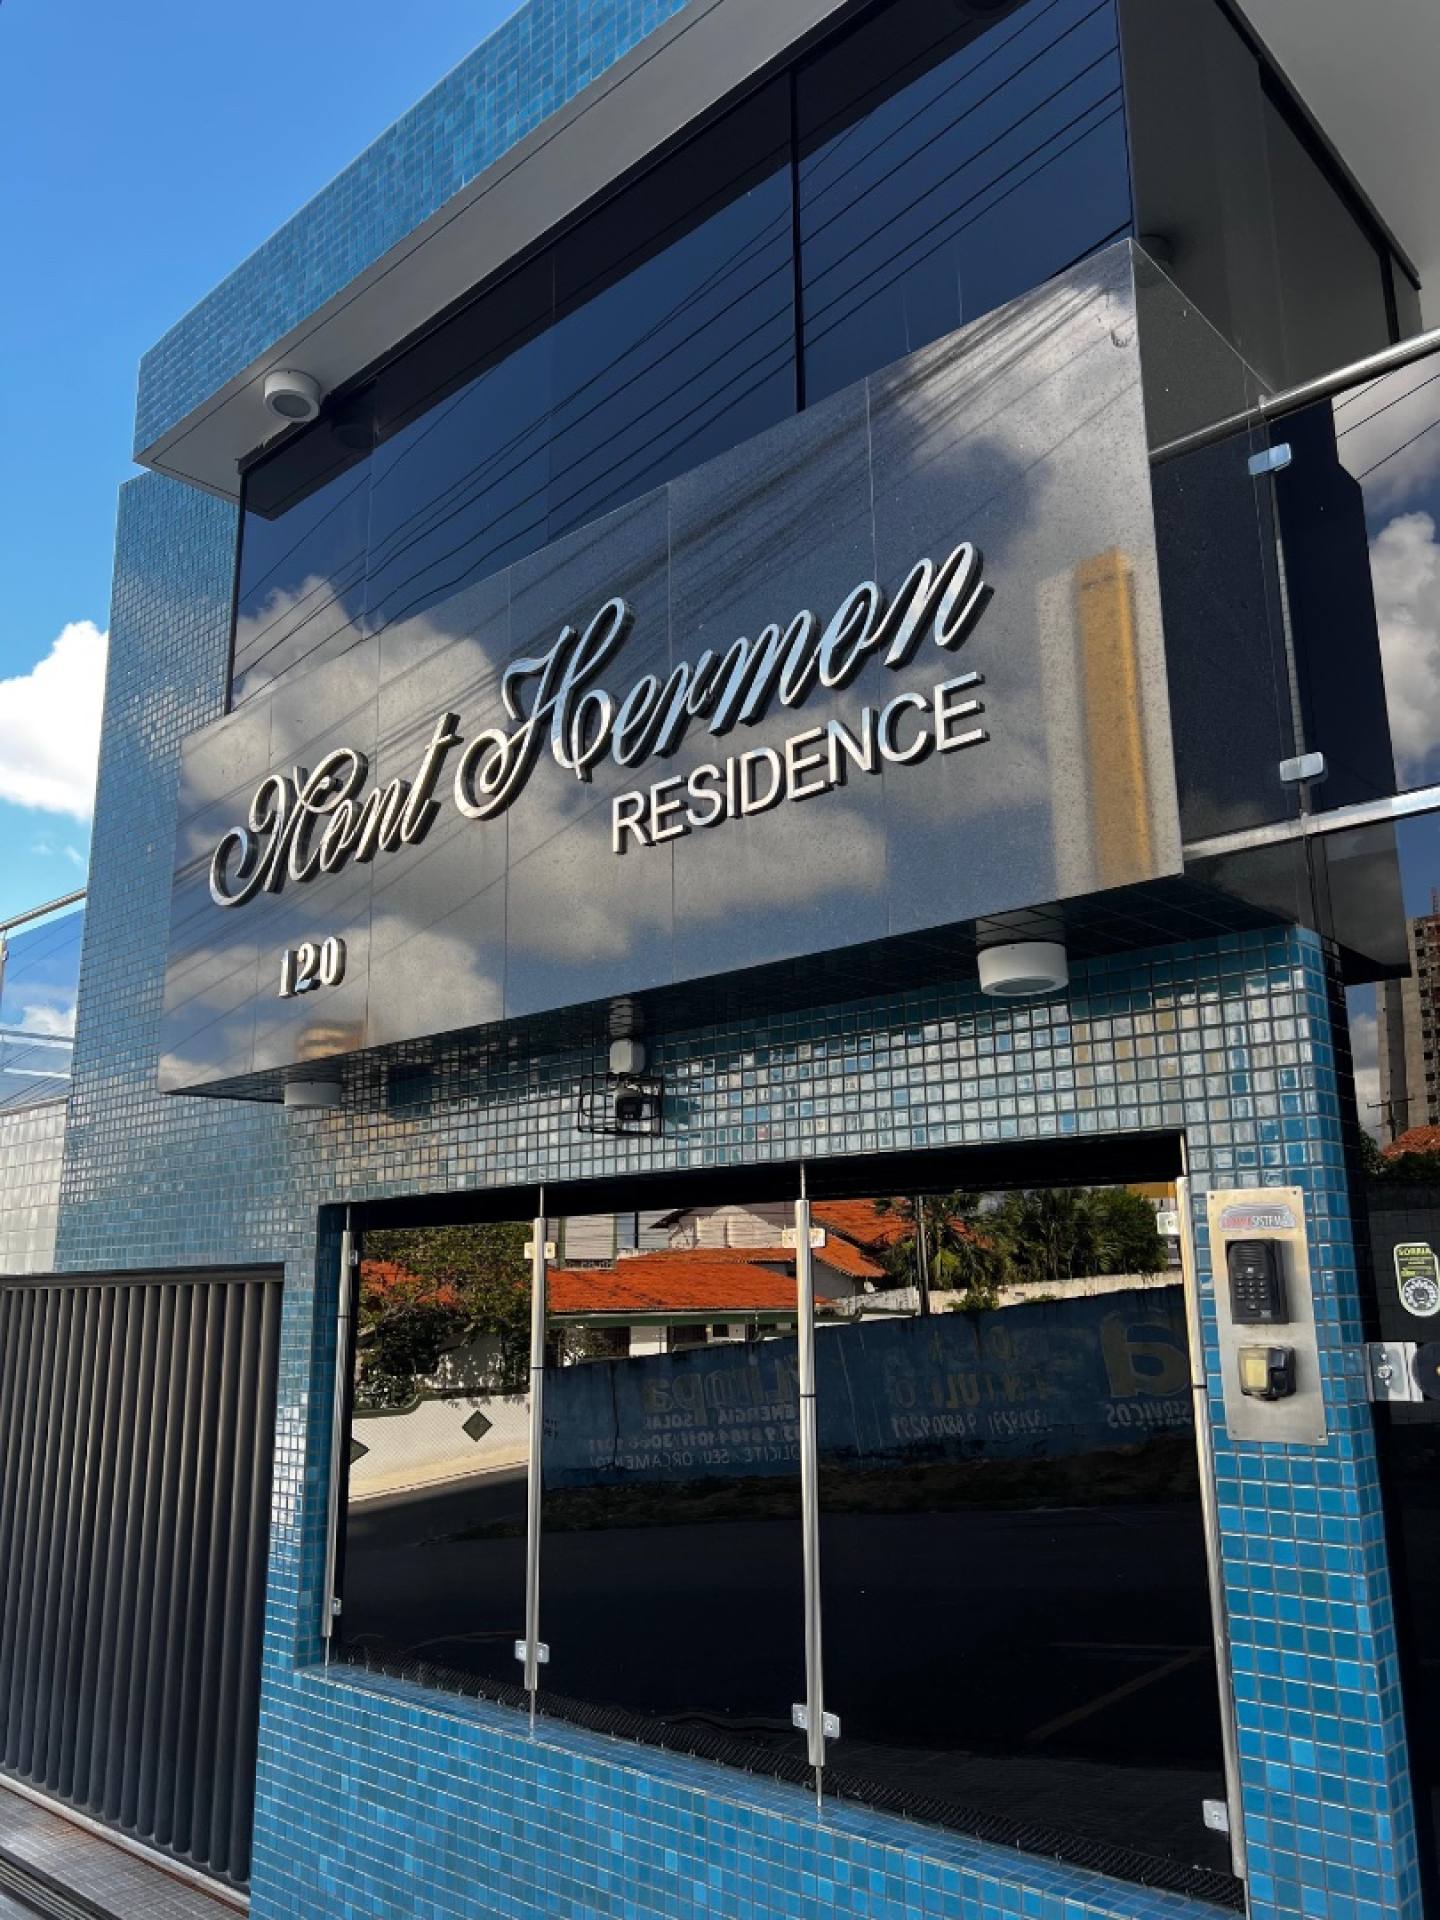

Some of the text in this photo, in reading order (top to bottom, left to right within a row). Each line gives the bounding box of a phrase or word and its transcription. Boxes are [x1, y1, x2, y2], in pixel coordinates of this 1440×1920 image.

[209, 541, 994, 907] Mont Hermon
[611, 671, 990, 855] RESIDENCE
[278, 936, 346, 999] 120
